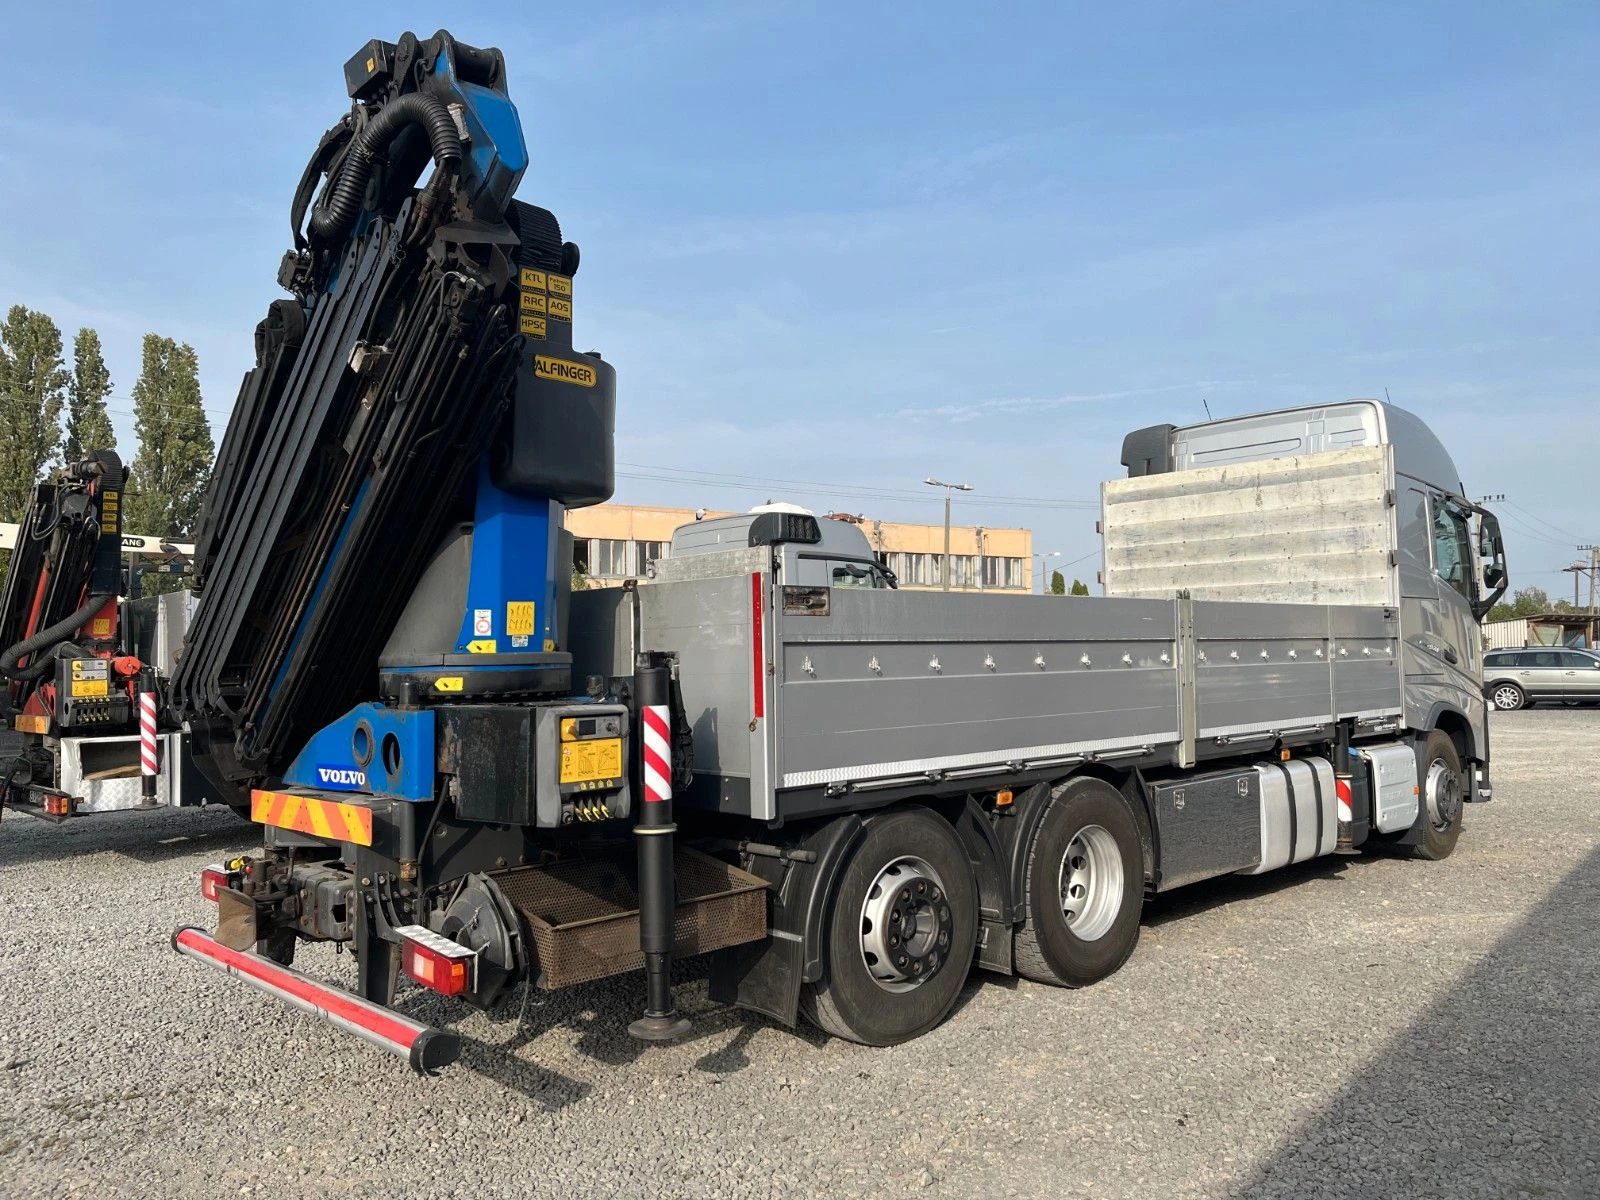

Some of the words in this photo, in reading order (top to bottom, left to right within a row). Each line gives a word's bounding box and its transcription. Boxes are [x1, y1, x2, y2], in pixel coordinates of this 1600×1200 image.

[525, 271, 542, 283] KTL
[523, 295, 544, 307] RRC
[550, 301, 569, 312] AOS
[521, 318, 545, 329] HPSC
[318, 768, 365, 785] VOLVO
